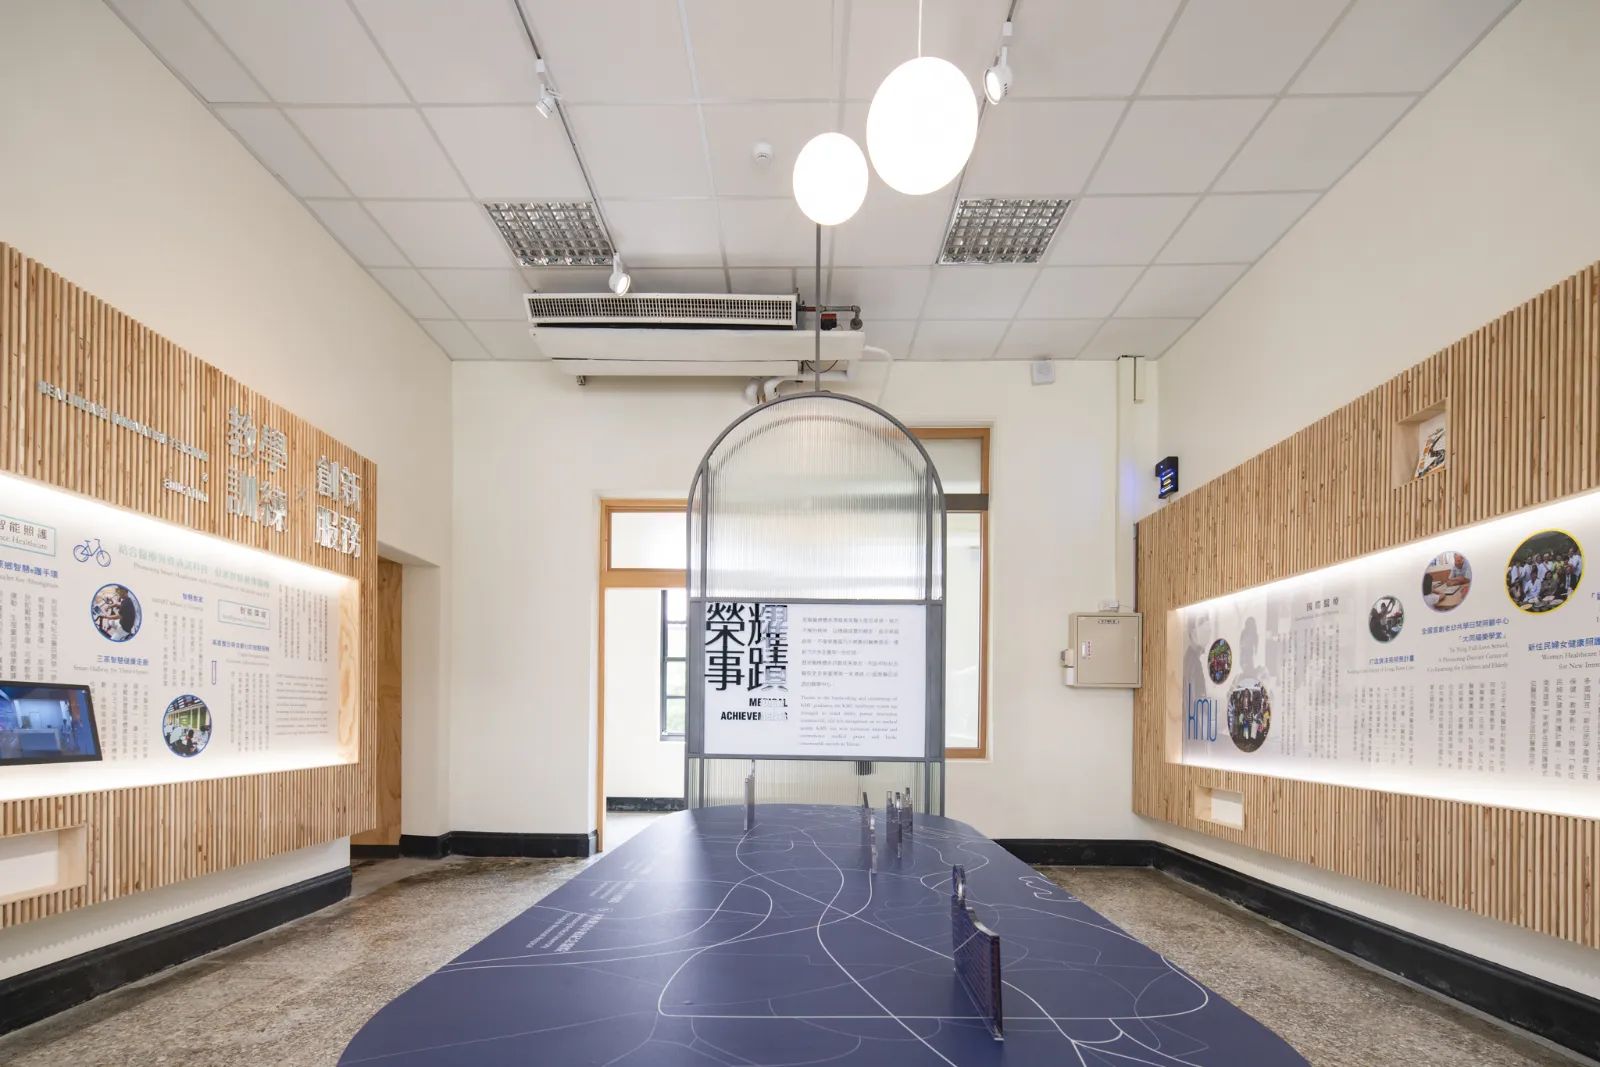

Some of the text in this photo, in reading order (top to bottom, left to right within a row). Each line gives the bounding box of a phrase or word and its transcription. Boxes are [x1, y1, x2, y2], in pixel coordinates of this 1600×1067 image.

[226, 405, 288, 473] 教學
[226, 465, 289, 532] 訓練
[316, 455, 362, 512] 創新
[315, 504, 362, 558] 服務
[705, 602, 788, 648] 榮耀
[704, 646, 788, 692] 事蹟
[749, 698, 788, 707] MEDICAL
[1188, 683, 1217, 742] kmu
